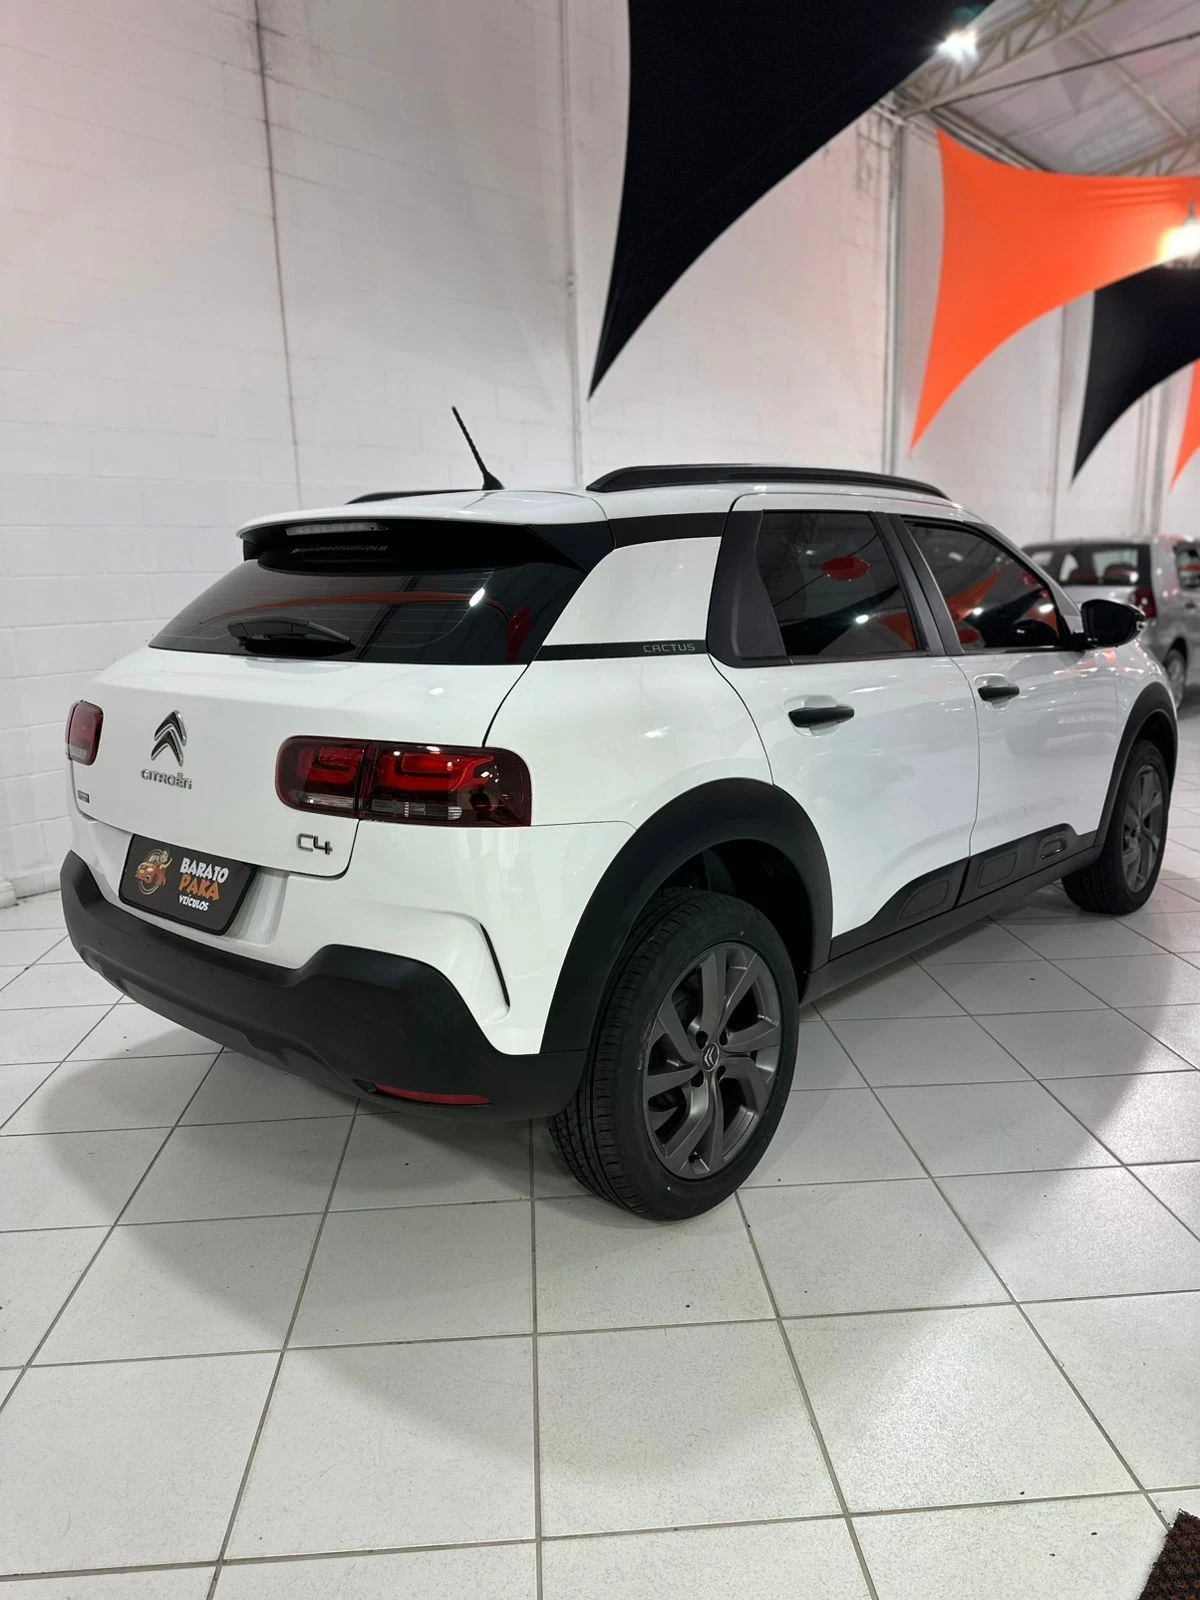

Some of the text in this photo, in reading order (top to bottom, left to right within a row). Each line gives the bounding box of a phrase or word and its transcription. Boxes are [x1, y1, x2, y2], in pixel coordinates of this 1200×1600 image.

[643, 643, 696, 653] CACTUS
[296, 833, 333, 855] C4
[180, 857, 229, 884] BARATO
[178, 873, 220, 901] PAKA
[179, 894, 209, 911] VEÍCULOS
